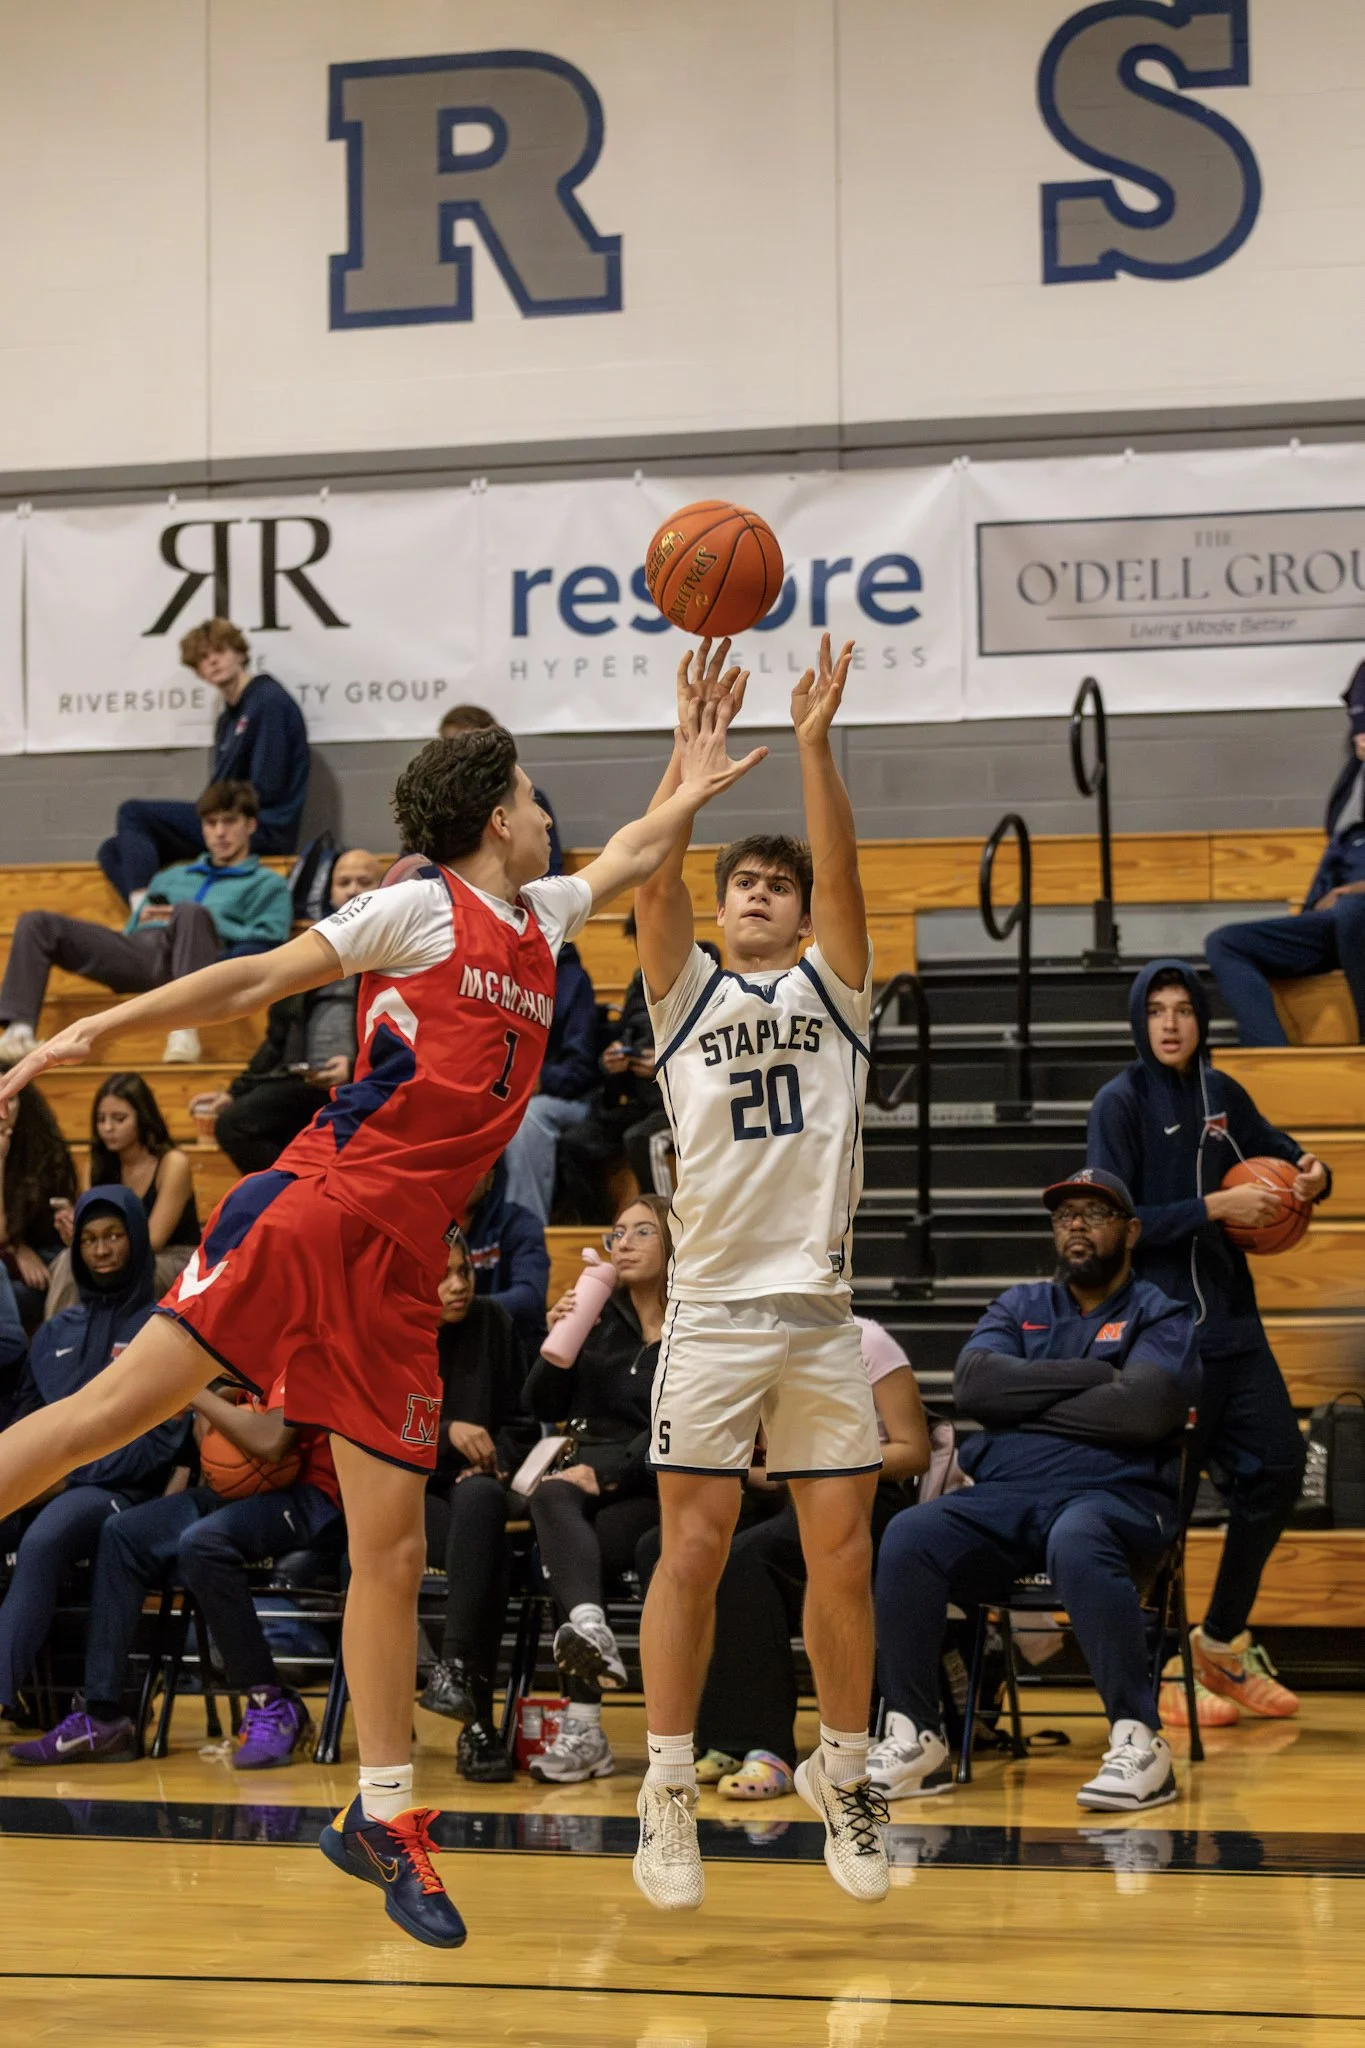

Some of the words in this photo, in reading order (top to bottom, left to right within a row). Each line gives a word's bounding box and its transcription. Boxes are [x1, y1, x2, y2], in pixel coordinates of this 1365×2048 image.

[328, 49, 624, 332] R
[1037, 0, 1262, 285] S
[511, 553, 923, 638] resre
[1016, 556, 1210, 606] O'DELL
[509, 654, 650, 680] HYPER
[691, 646, 927, 674] ELLESS
[58, 687, 206, 715] RIVERSIDE
[344, 679, 449, 704] GROUP
[459, 963, 554, 1030] MCMAHON
[490, 1029, 520, 1101] 1
[698, 1015, 823, 1067] STAPLES
[729, 1063, 805, 1142] 20
[658, 1420, 671, 1455] S
